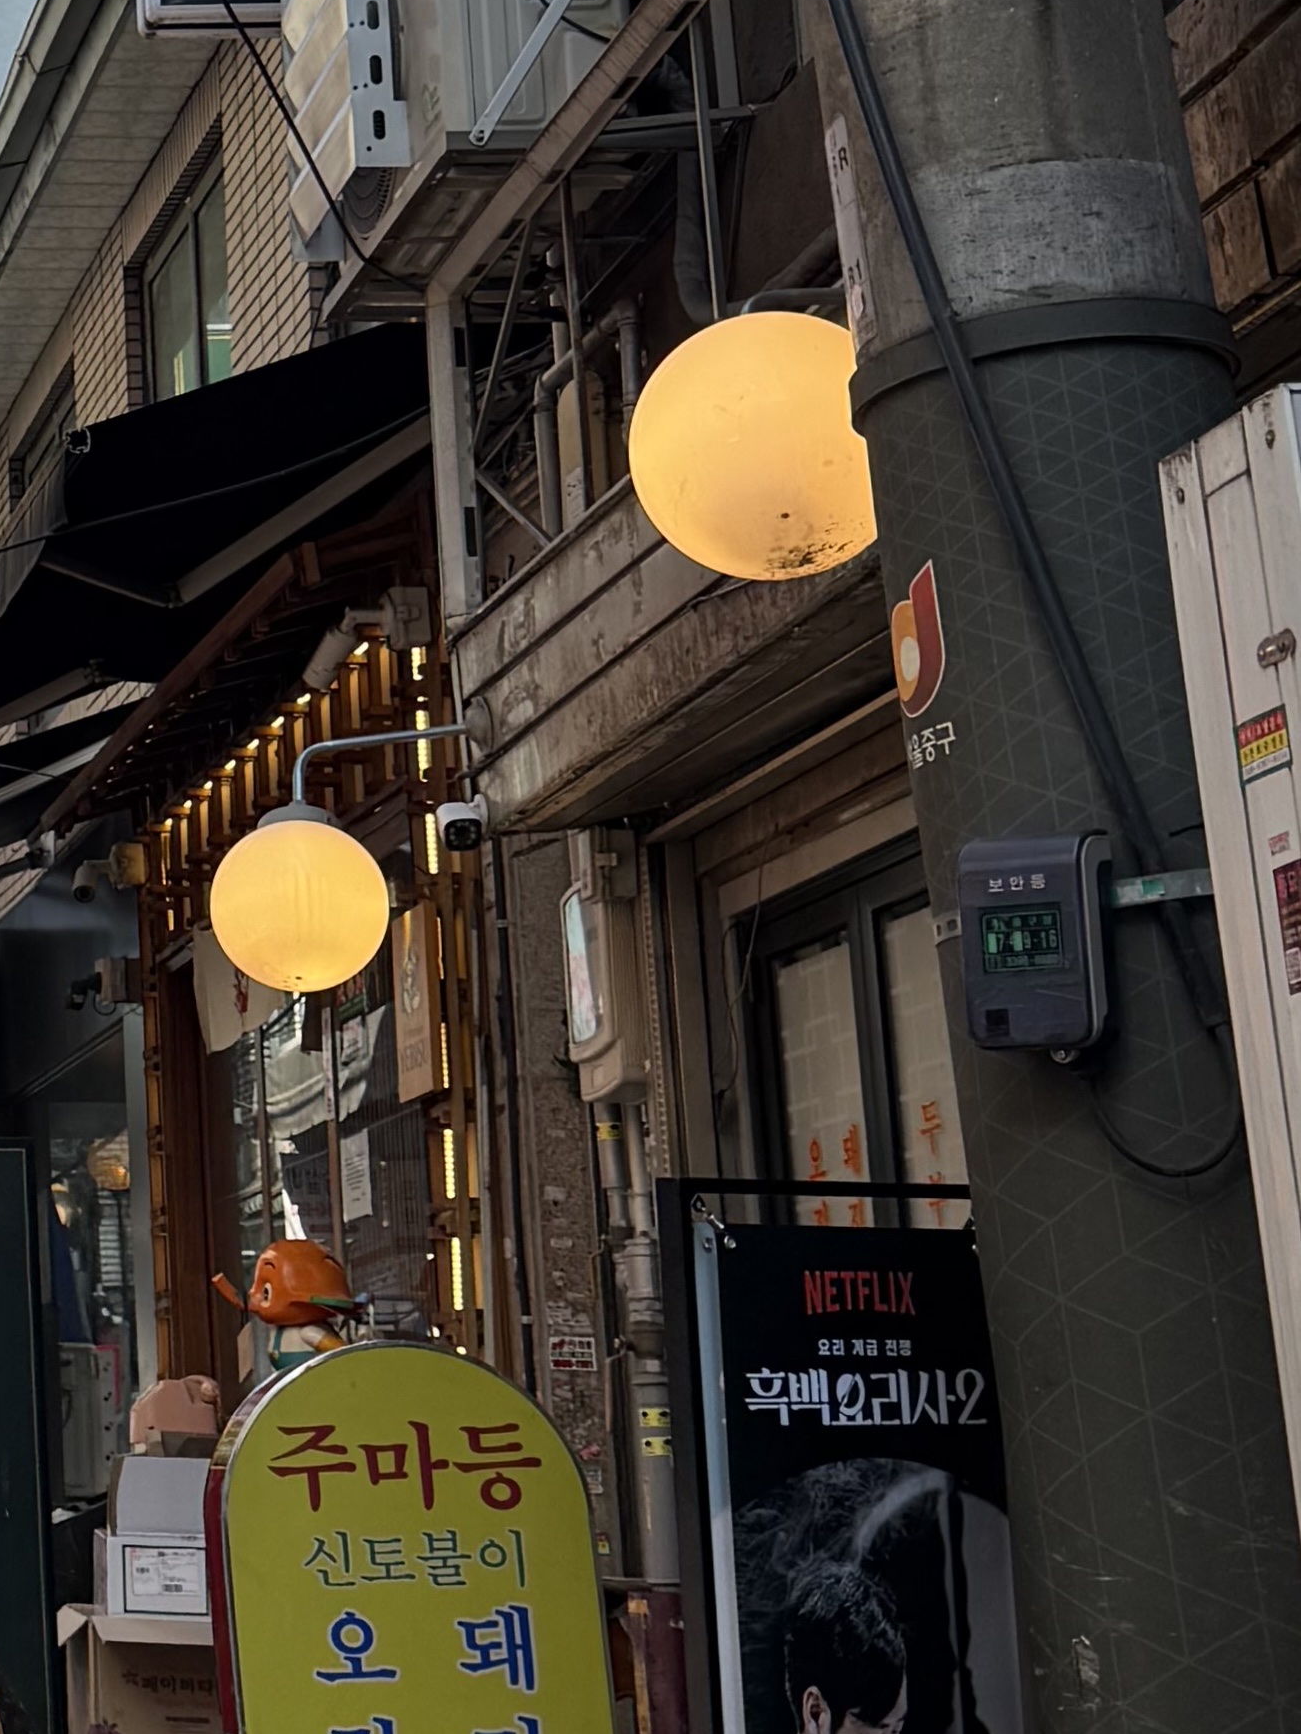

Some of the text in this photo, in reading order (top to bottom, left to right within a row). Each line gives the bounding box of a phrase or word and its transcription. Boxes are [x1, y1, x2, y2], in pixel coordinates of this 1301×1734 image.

[803, 1270, 916, 1316] NETFLIX
[818, 1338, 845, 1356] 요리
[852, 1338, 878, 1357] 계급
[744, 1367, 988, 1426] 흑백요리사2
[268, 1421, 543, 1513] 주마등
[302, 1526, 530, 1590] 신토불이
